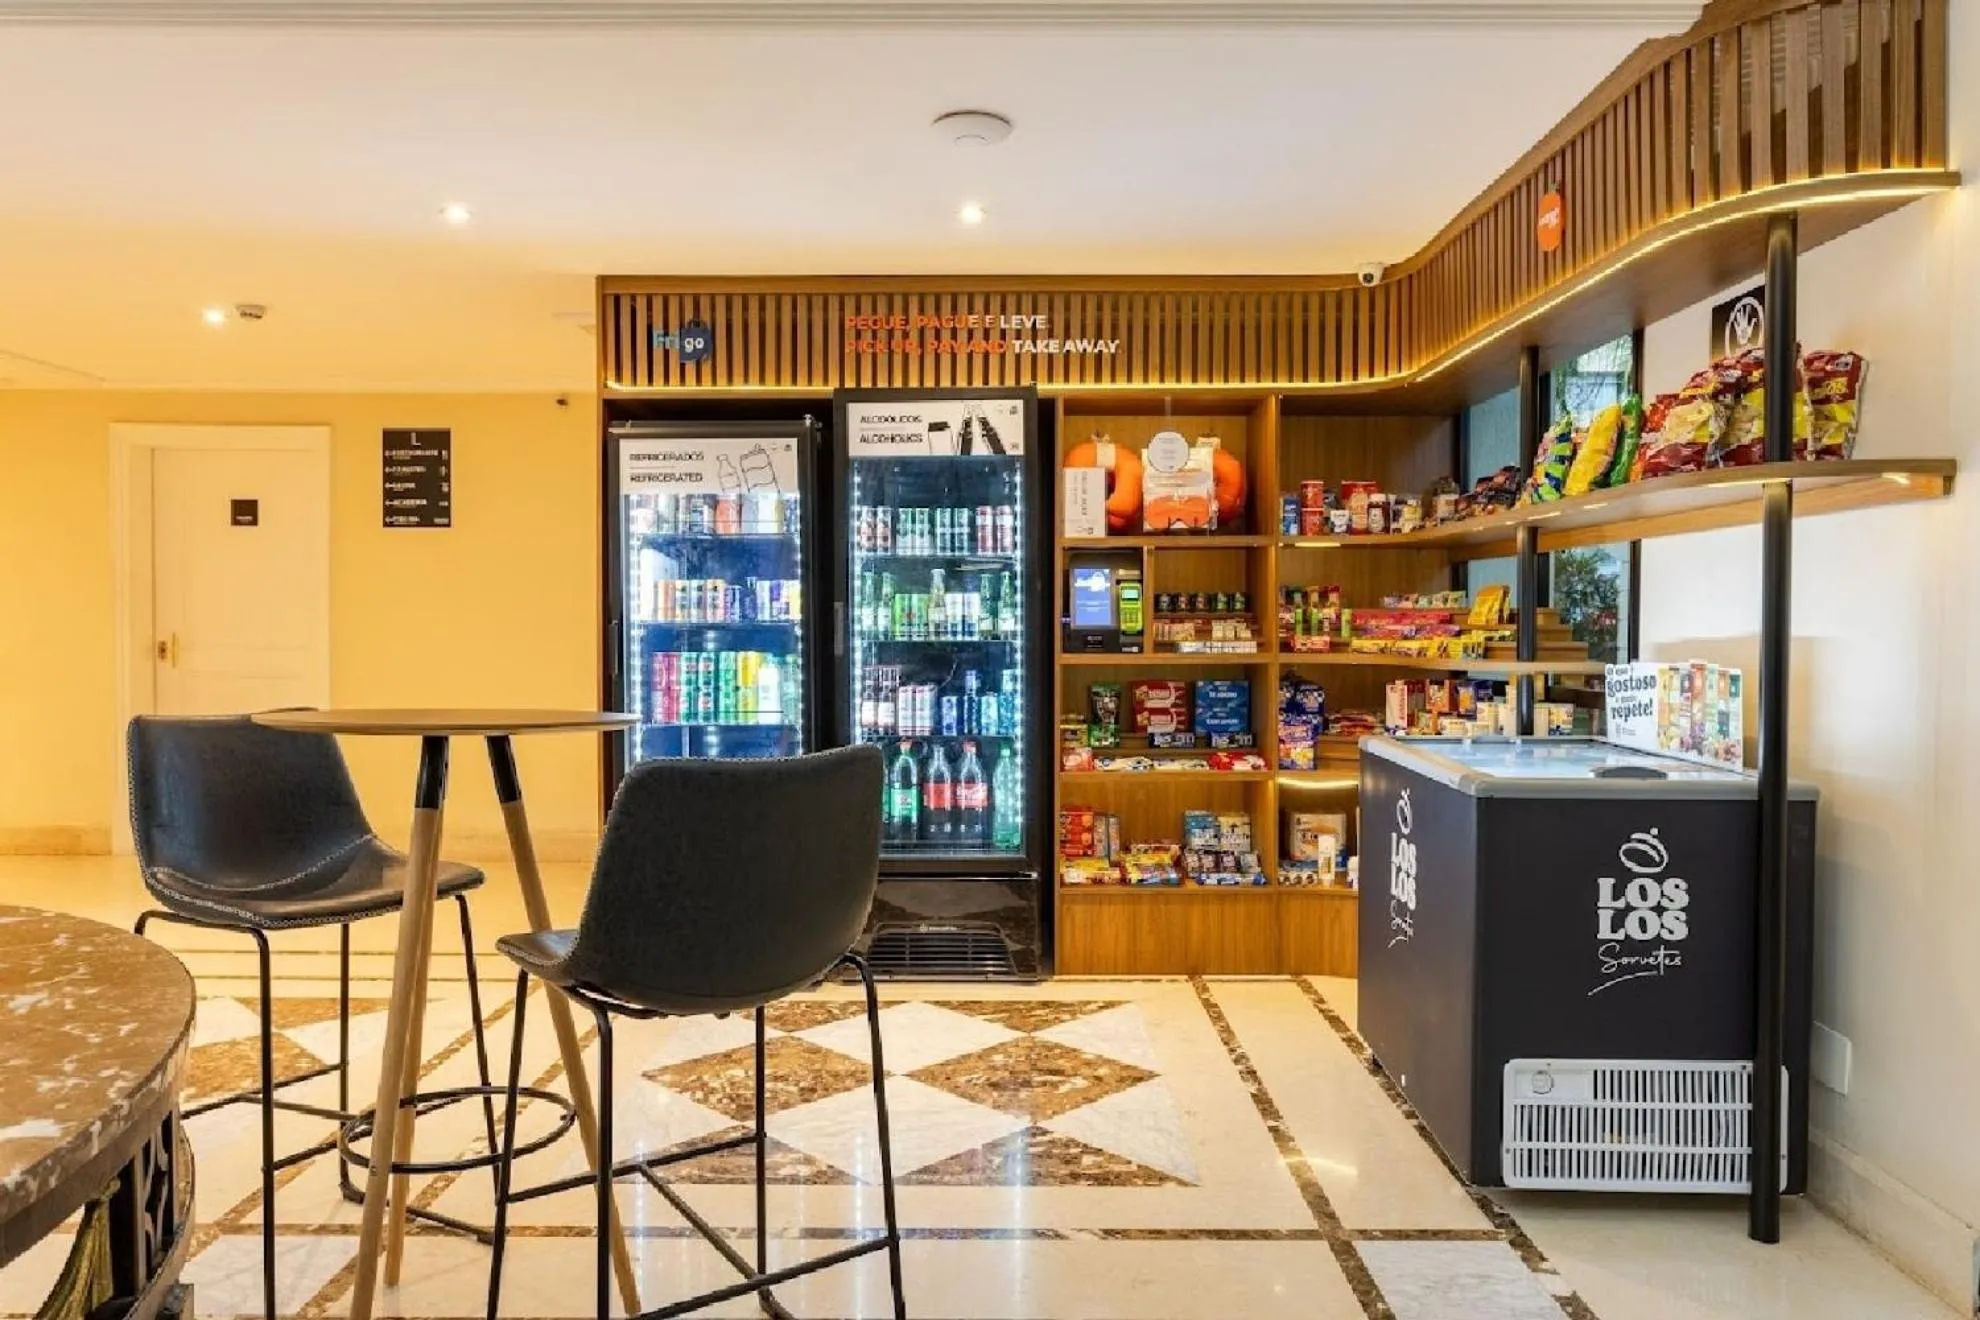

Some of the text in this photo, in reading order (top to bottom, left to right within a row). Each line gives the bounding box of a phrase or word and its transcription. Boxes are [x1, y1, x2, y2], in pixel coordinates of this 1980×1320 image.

[917, 314, 979, 329] PAGUE
[1012, 339, 1060, 354] TAKE
[411, 432, 421, 445] L
[1607, 675, 1657, 697] gostoso
[1611, 698, 1653, 722] repete!
[1597, 877, 1690, 908] LOS
[1597, 909, 1689, 941] LOS
[1598, 943, 1682, 975] Sorvetes
